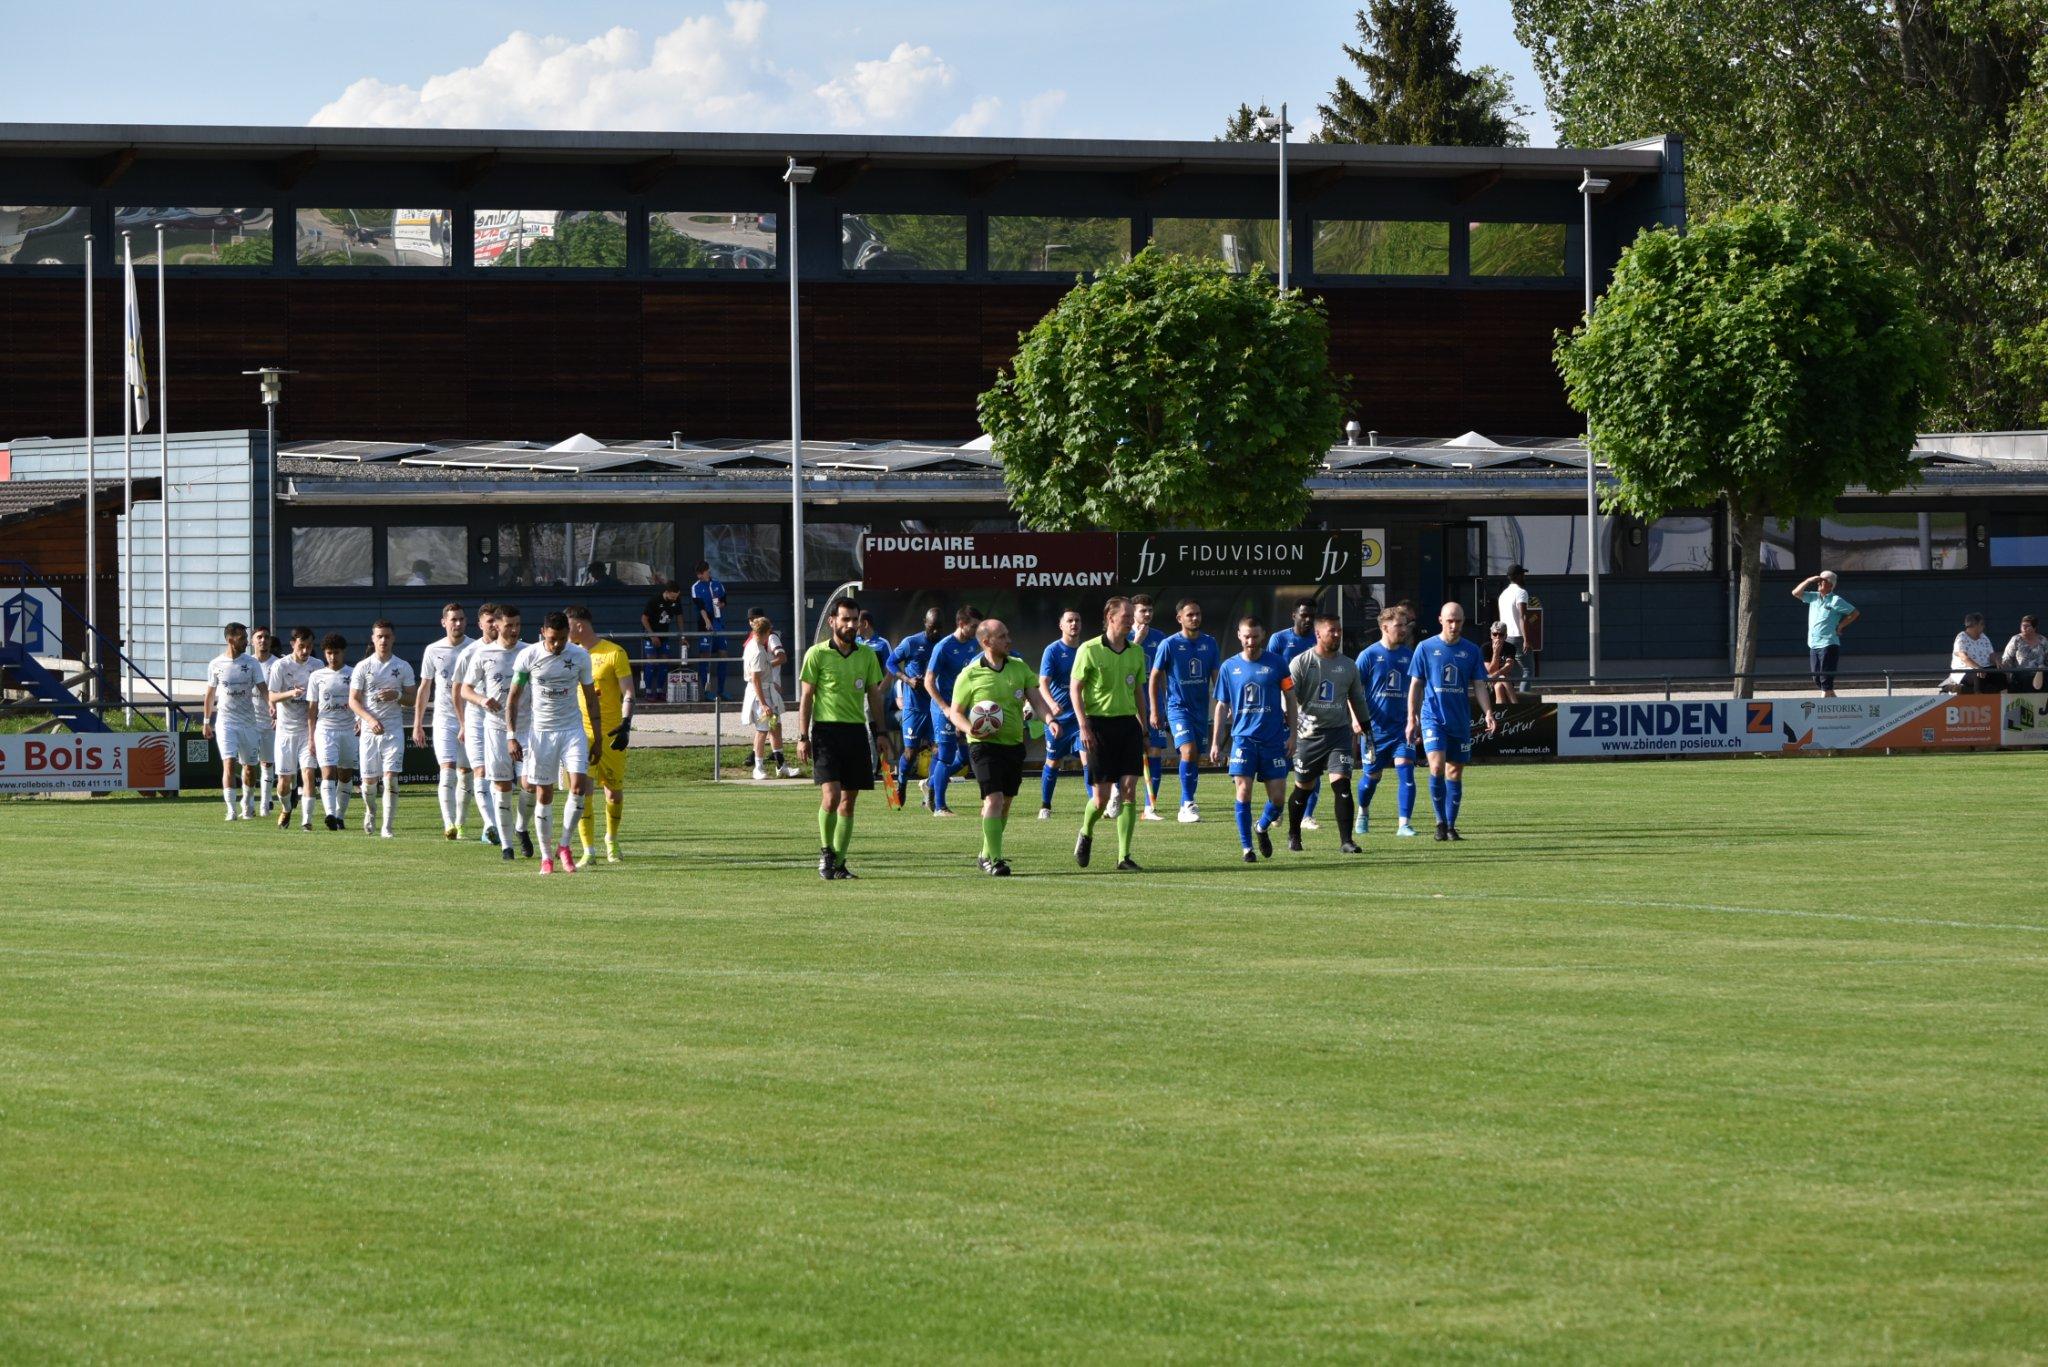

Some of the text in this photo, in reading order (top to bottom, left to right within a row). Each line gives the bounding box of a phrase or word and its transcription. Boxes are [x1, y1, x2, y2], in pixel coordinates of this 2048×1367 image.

[865, 537, 974, 551] FIDUCIAIRE
[1179, 544, 1303, 561] FIDUVISION
[944, 555, 1038, 569] BULLIARD
[1016, 572, 1115, 586] FARVAGNY
[1817, 704, 1863, 713] HISTORIKA
[1569, 703, 1728, 737] ZBINDEN
[1501, 719, 1536, 737] futur
[1602, 736, 1742, 750] www.zbinden posieux.ch
[25, 738, 103, 770] Bois
[0, 780, 65, 789] www.rollebois.ch
[114, 779, 122, 787] 18
